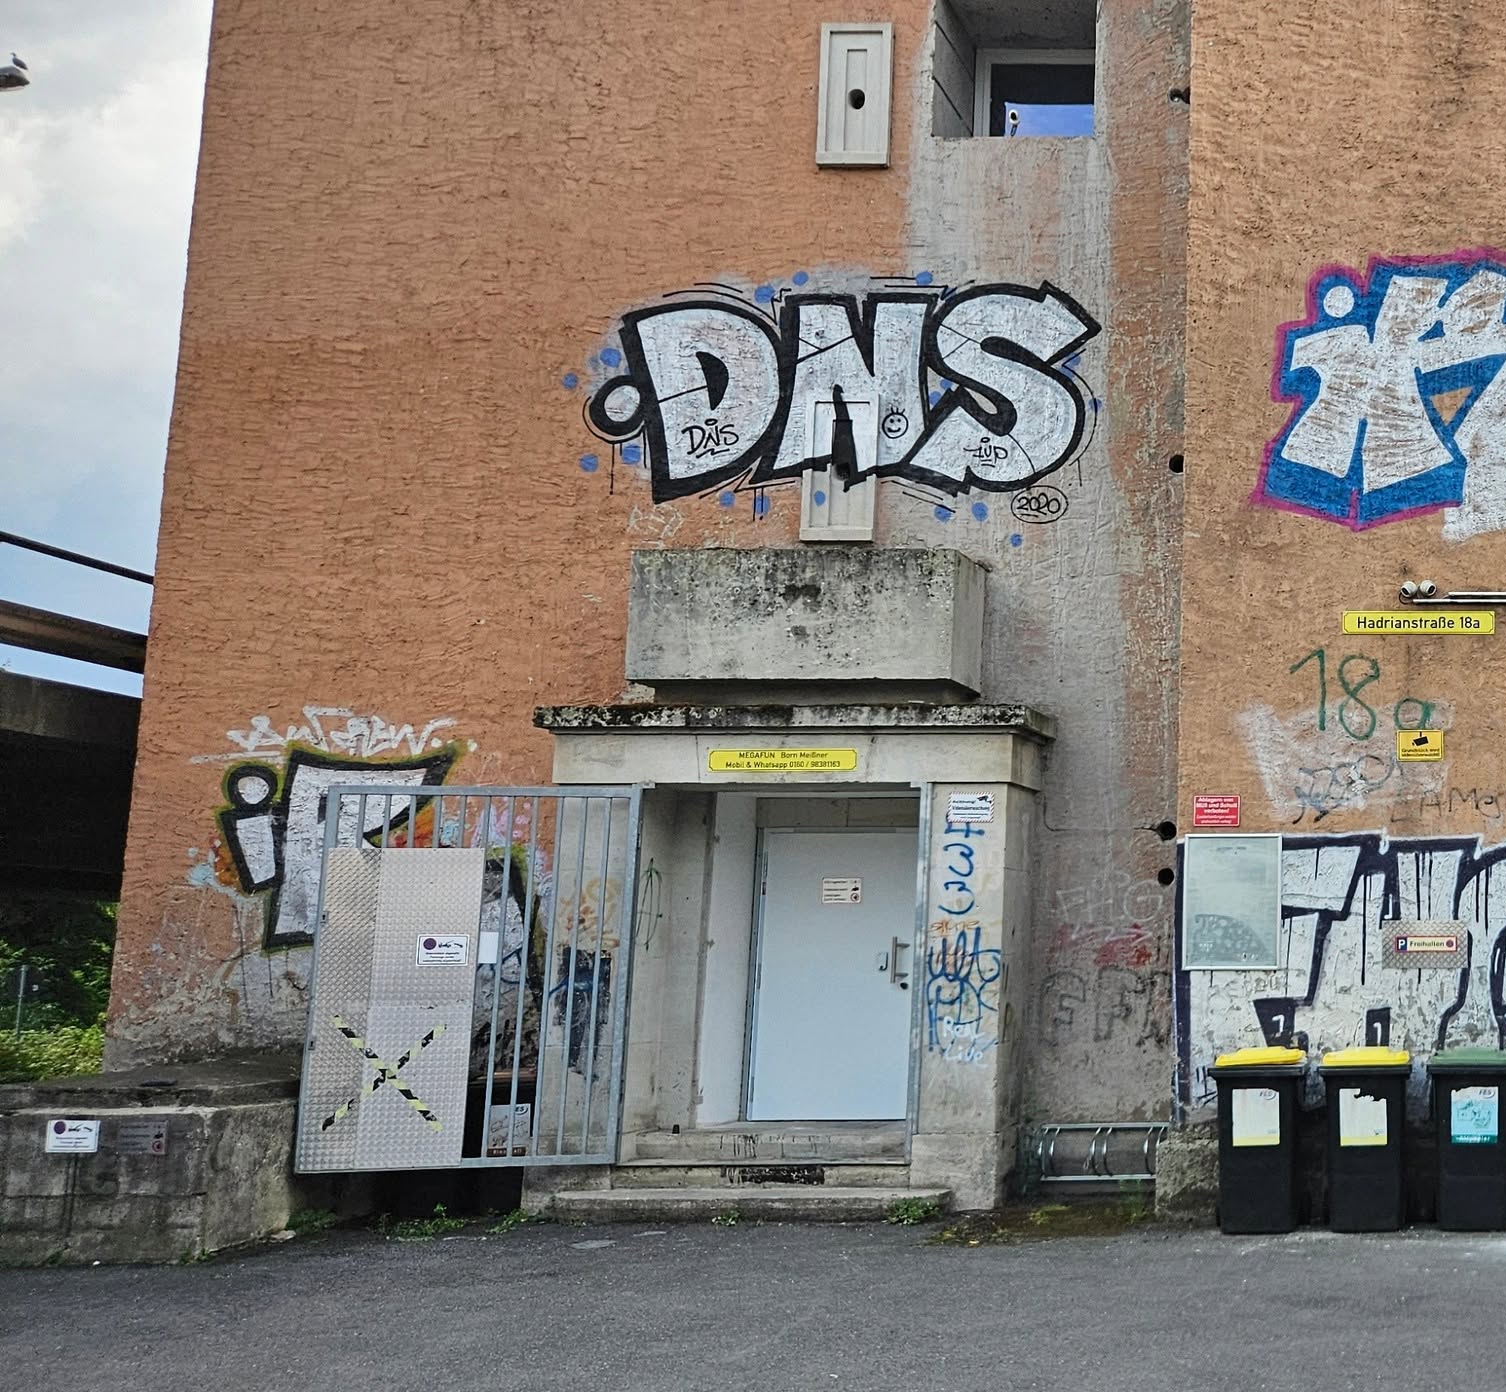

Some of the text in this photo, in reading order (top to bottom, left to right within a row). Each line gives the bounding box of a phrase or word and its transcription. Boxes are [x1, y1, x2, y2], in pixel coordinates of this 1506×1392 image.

[1357, 616, 1480, 629] Hadrianstraße 18a
[753, 761, 788, 769] Whatsapp
[1398, 939, 1406, 950] P
